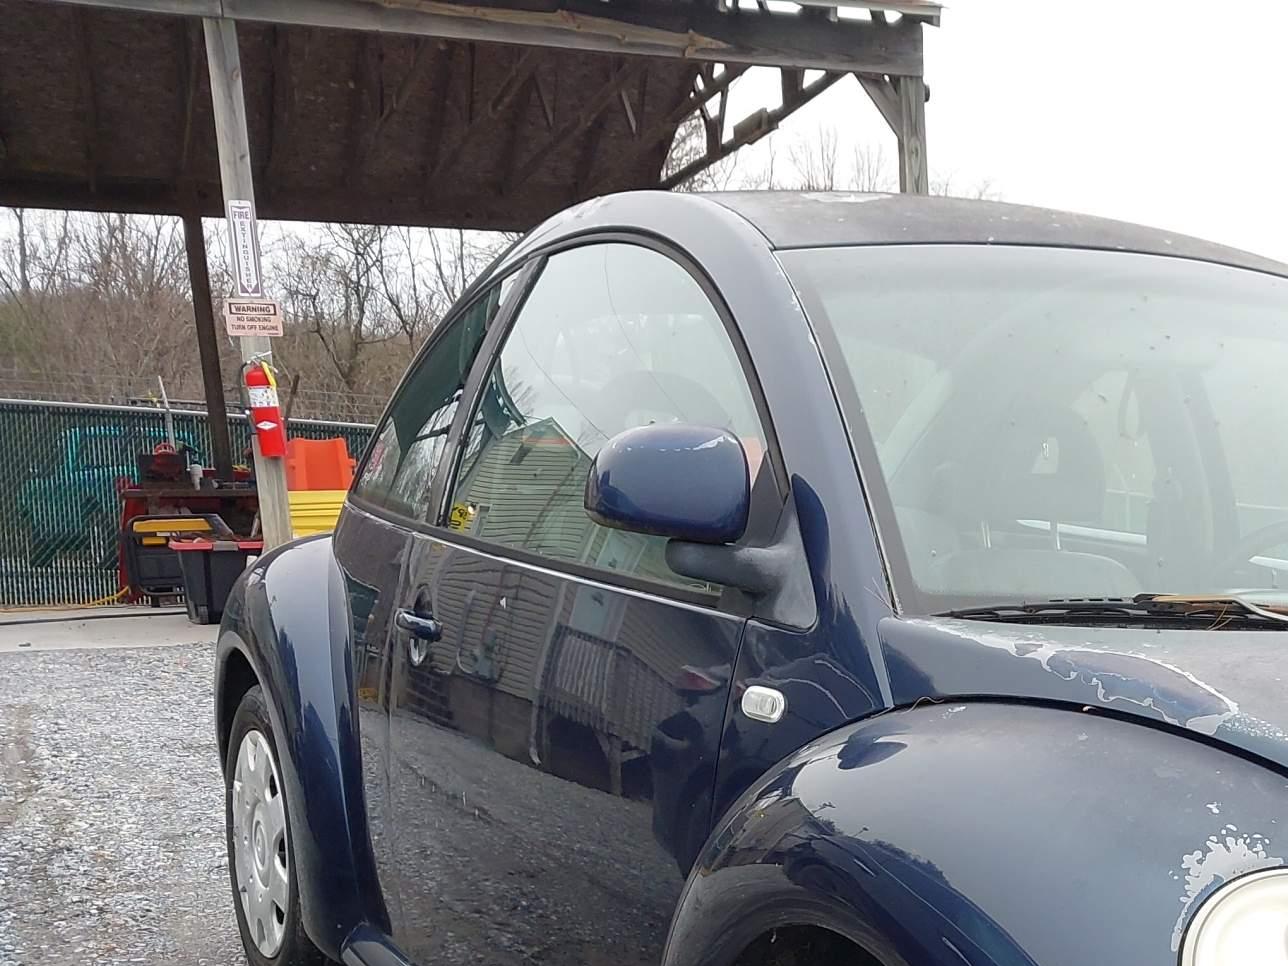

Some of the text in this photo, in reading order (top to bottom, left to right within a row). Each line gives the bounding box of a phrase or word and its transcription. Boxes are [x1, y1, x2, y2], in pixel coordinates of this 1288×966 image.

[233, 211, 249, 220] FIRE
[239, 221, 253, 289] EXTINGUISHER
[234, 305, 271, 313] WARNING
